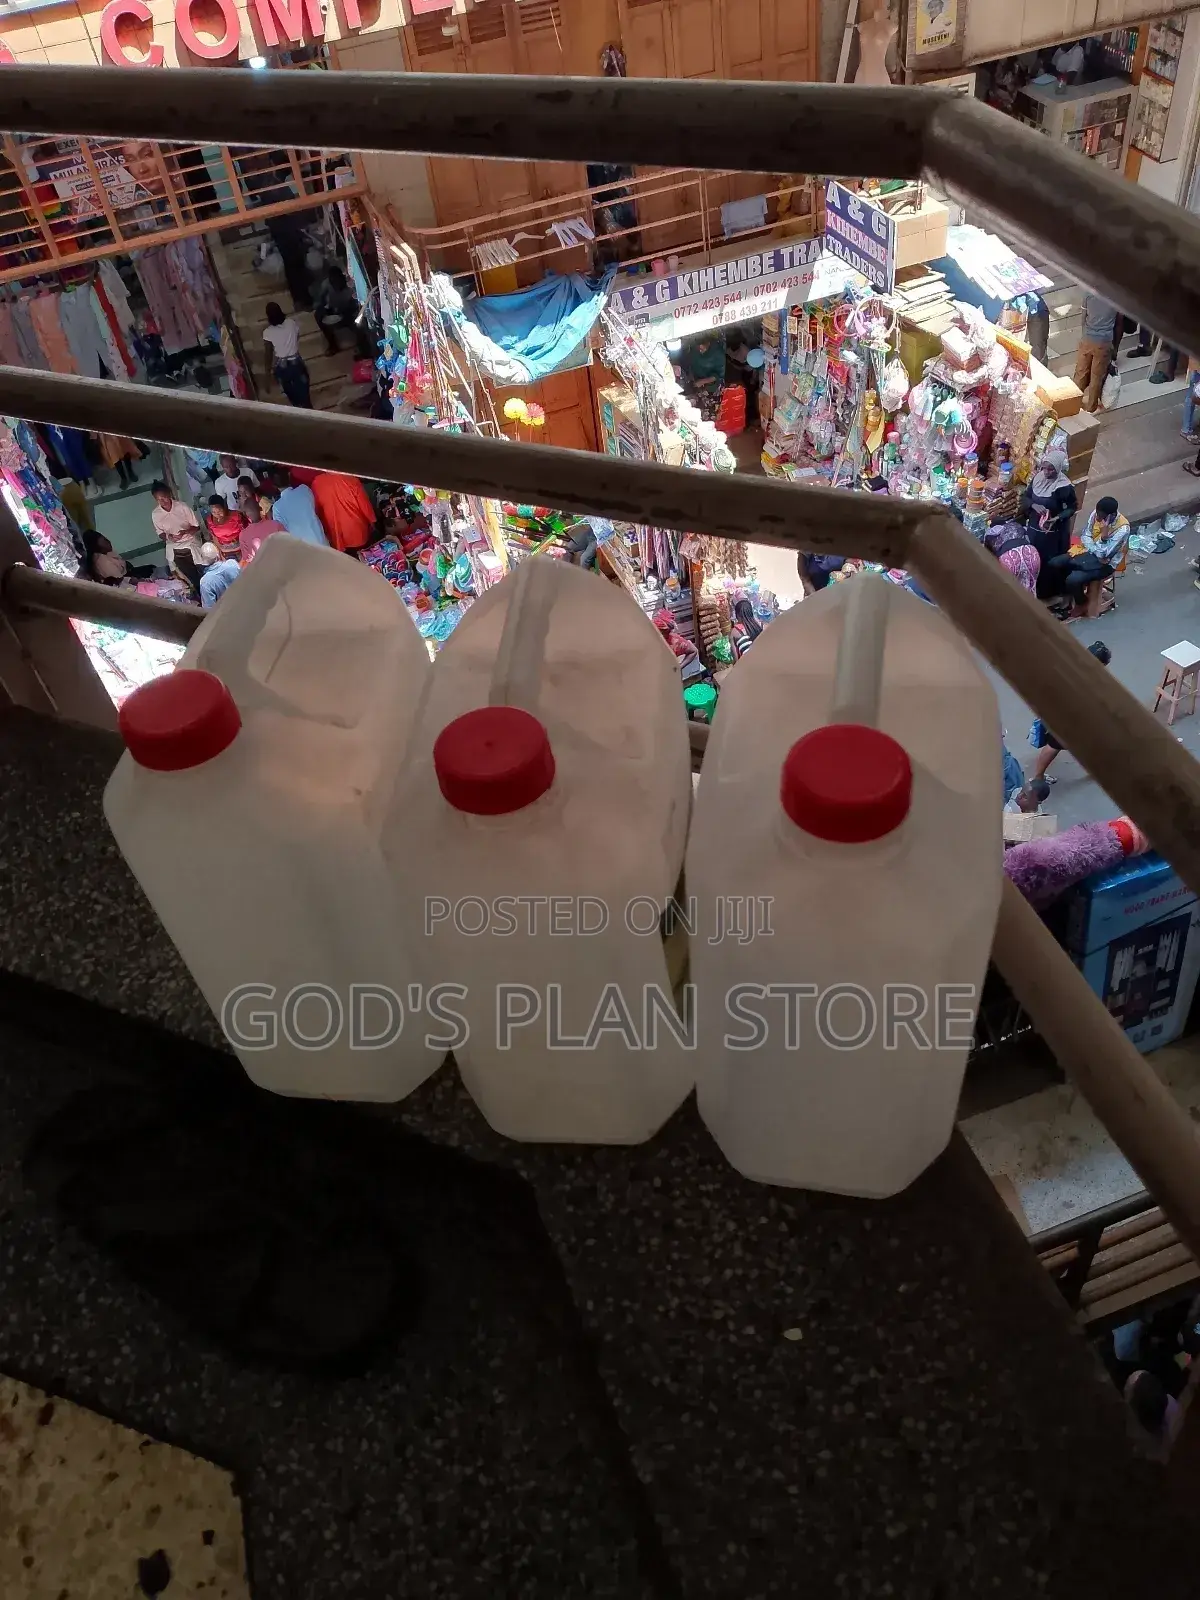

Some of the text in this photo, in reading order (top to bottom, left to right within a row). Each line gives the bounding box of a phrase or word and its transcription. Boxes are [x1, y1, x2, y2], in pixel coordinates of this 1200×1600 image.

[826, 181, 887, 239] A & G
[826, 209, 887, 266] KIHEMBE
[609, 239, 823, 314] A & G KIHEMBE TRA
[826, 234, 885, 288] TRADERS
[674, 303, 700, 319] 0772
[701, 297, 721, 312] 423
[723, 291, 742, 306] 544
[753, 282, 778, 298] 0702
[780, 276, 799, 290] 423
[739, 303, 758, 319] 439
[760, 298, 778, 313] 211
